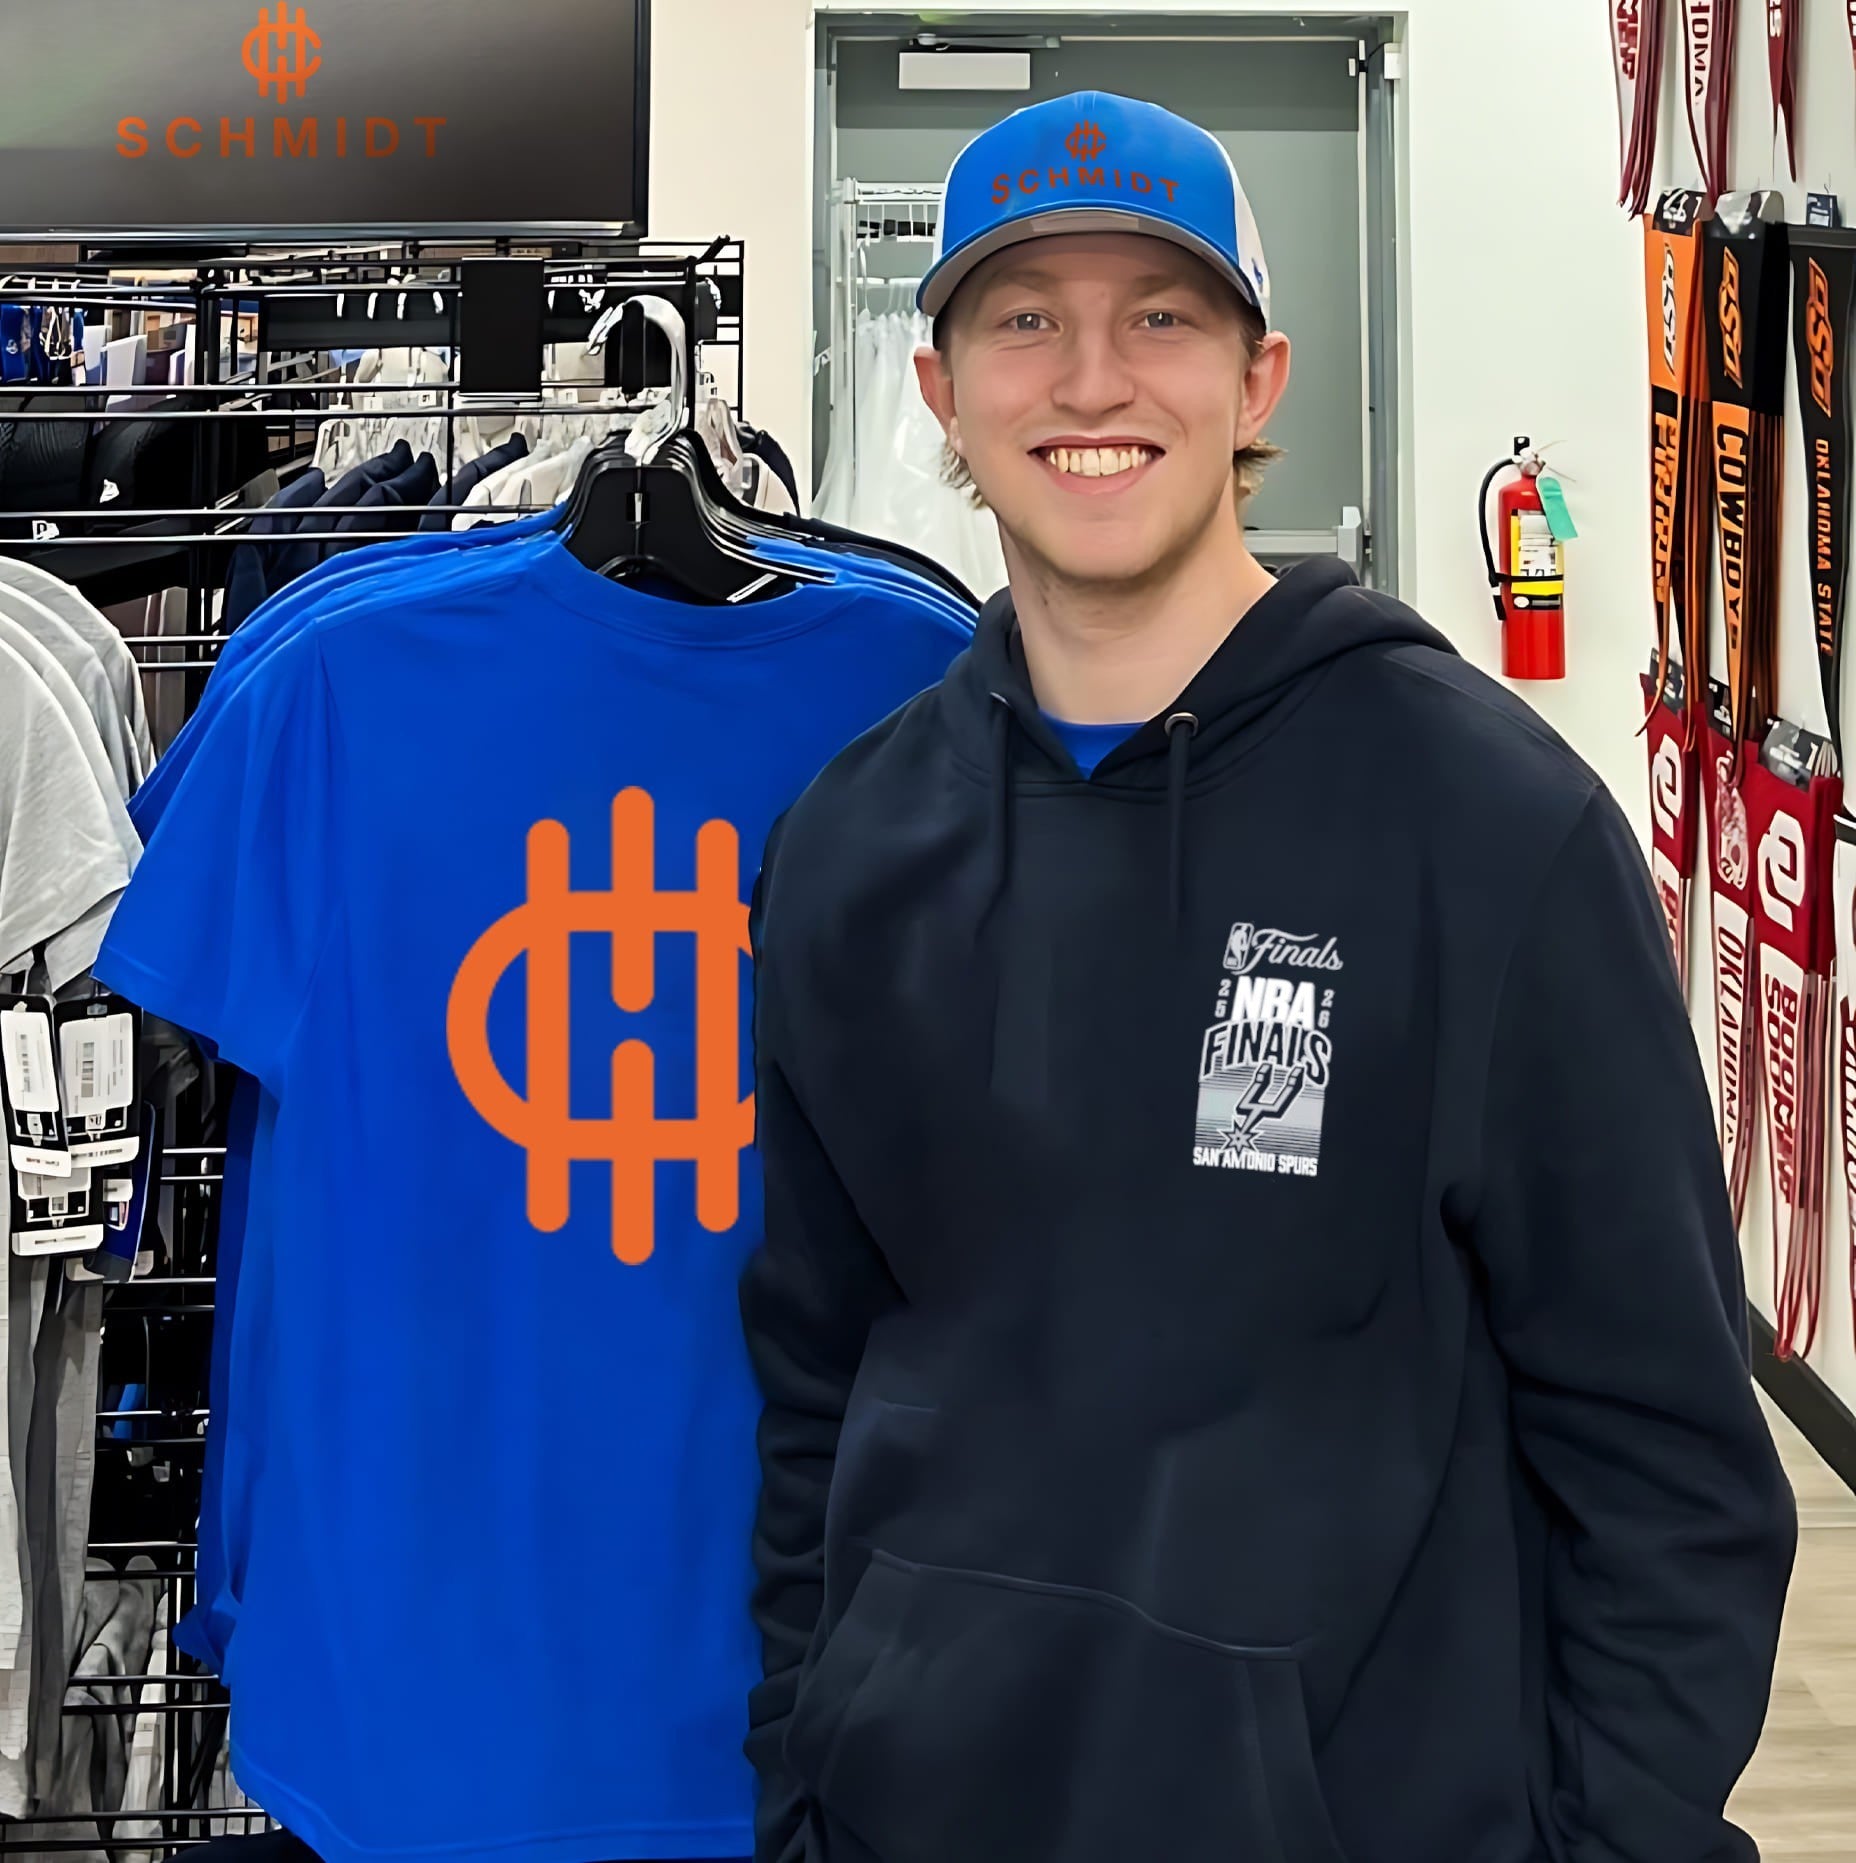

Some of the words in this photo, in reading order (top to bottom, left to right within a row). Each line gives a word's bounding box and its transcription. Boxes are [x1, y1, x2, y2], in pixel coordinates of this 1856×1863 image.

[116, 117, 448, 158] SCHMIDT
[991, 166, 1180, 205] SCHMIDT
[1814, 438, 1833, 571] OKLAHOMA
[1231, 928, 1344, 976] Finals
[1231, 975, 1316, 1032] NBA
[1200, 1019, 1333, 1089] FINALS
[1717, 924, 1746, 1144] OKLAHOMA
[1193, 1146, 1221, 1168] SAN
[1221, 1147, 1276, 1173] ANTONIO
[1277, 1154, 1319, 1177] SPURS
